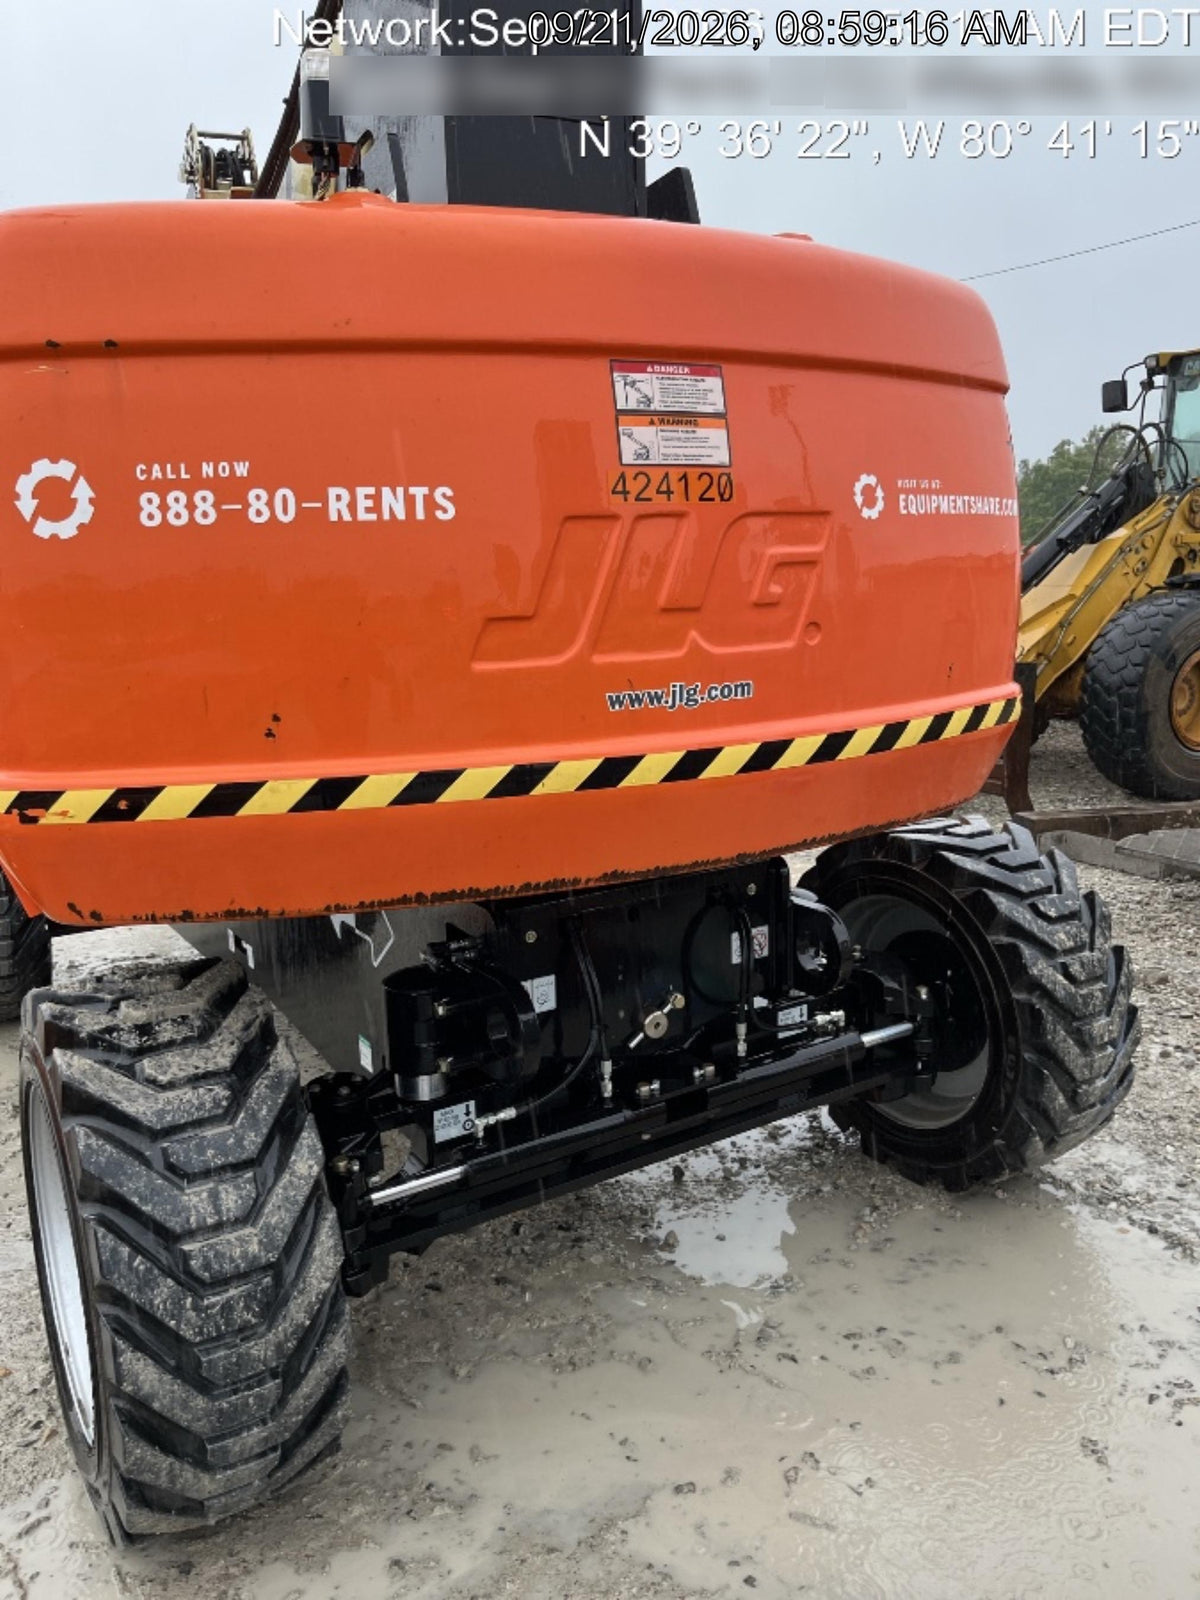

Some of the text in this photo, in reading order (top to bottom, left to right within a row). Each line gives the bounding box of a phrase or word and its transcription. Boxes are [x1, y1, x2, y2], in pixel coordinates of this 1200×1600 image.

[653, 365, 691, 374] DANGER
[136, 461, 250, 480] CALL NOW
[611, 471, 733, 502] 424120
[139, 486, 457, 527] 888-80-RENTS
[606, 680, 754, 712] www.jlg.com
